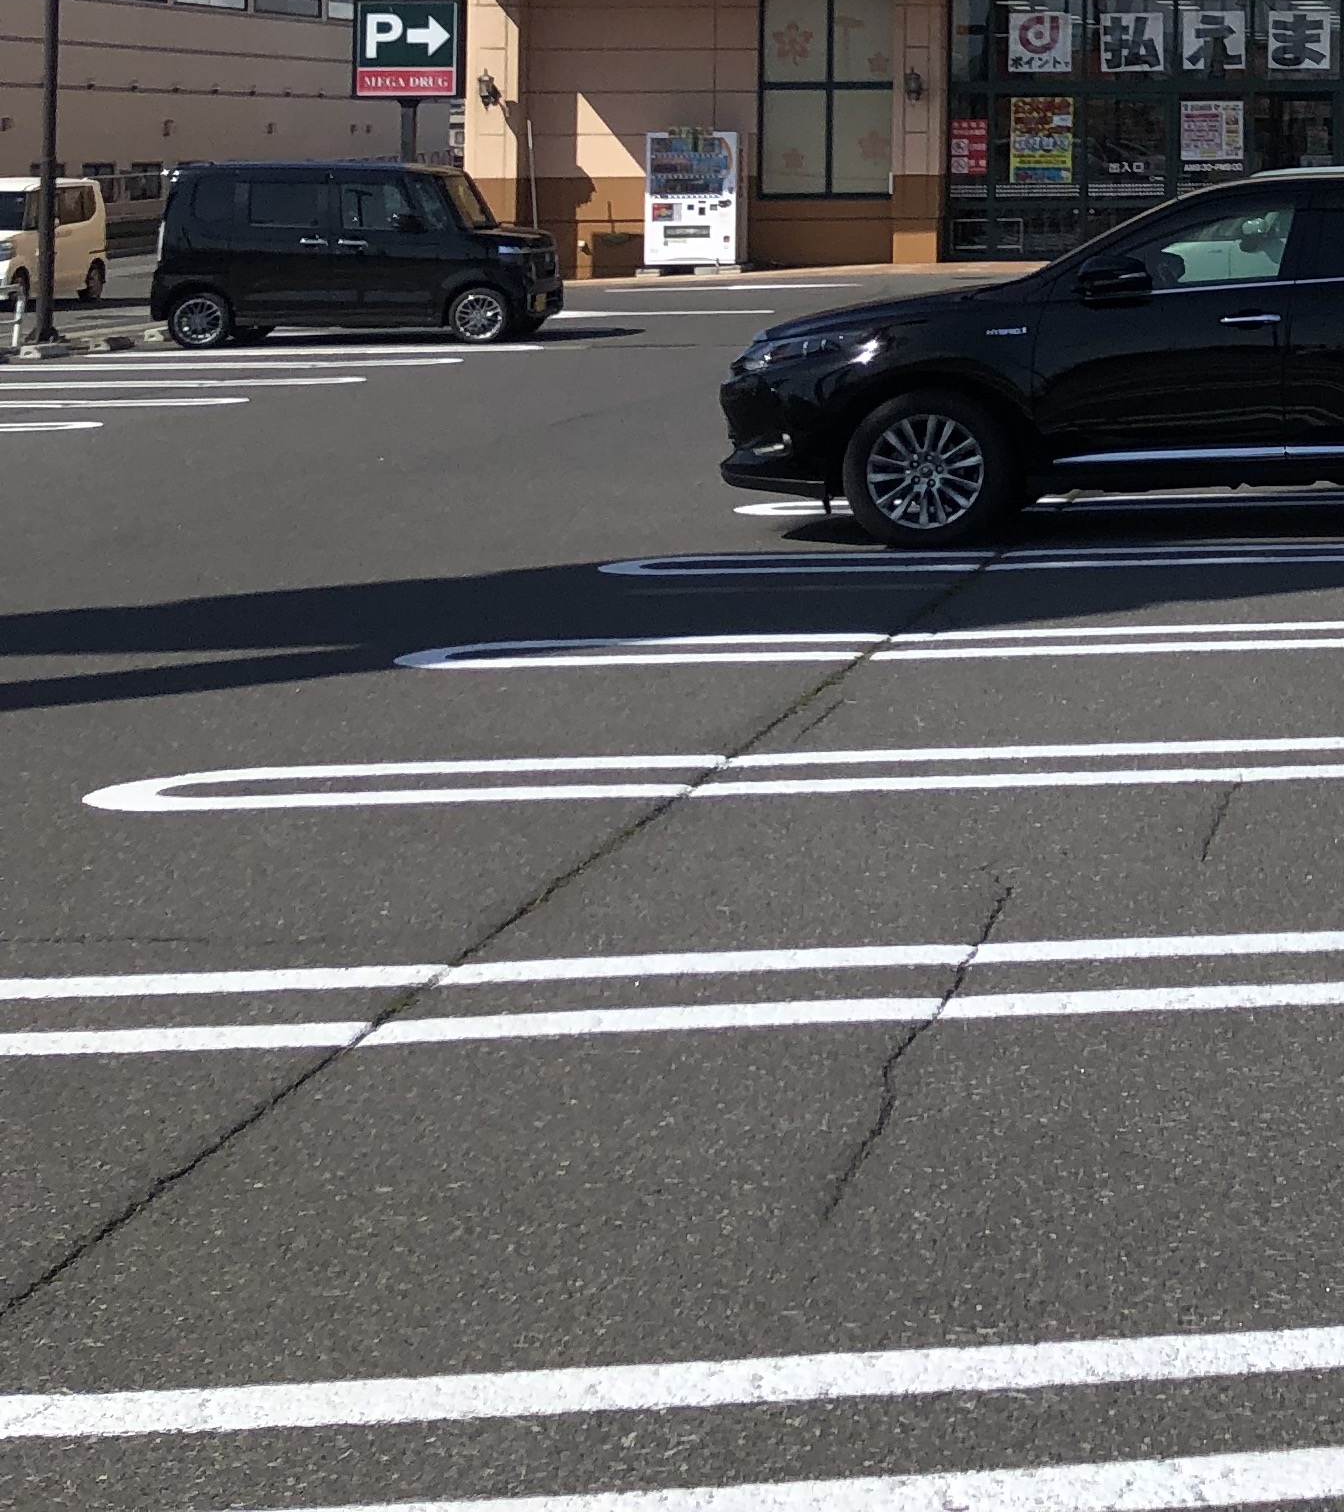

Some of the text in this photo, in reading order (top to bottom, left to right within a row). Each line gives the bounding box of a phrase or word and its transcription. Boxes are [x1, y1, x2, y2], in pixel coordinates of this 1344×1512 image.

[365, 13, 403, 59] P
[364, 76, 449, 88] MEGA DRUG
[1108, 161, 1145, 173] 出入口
